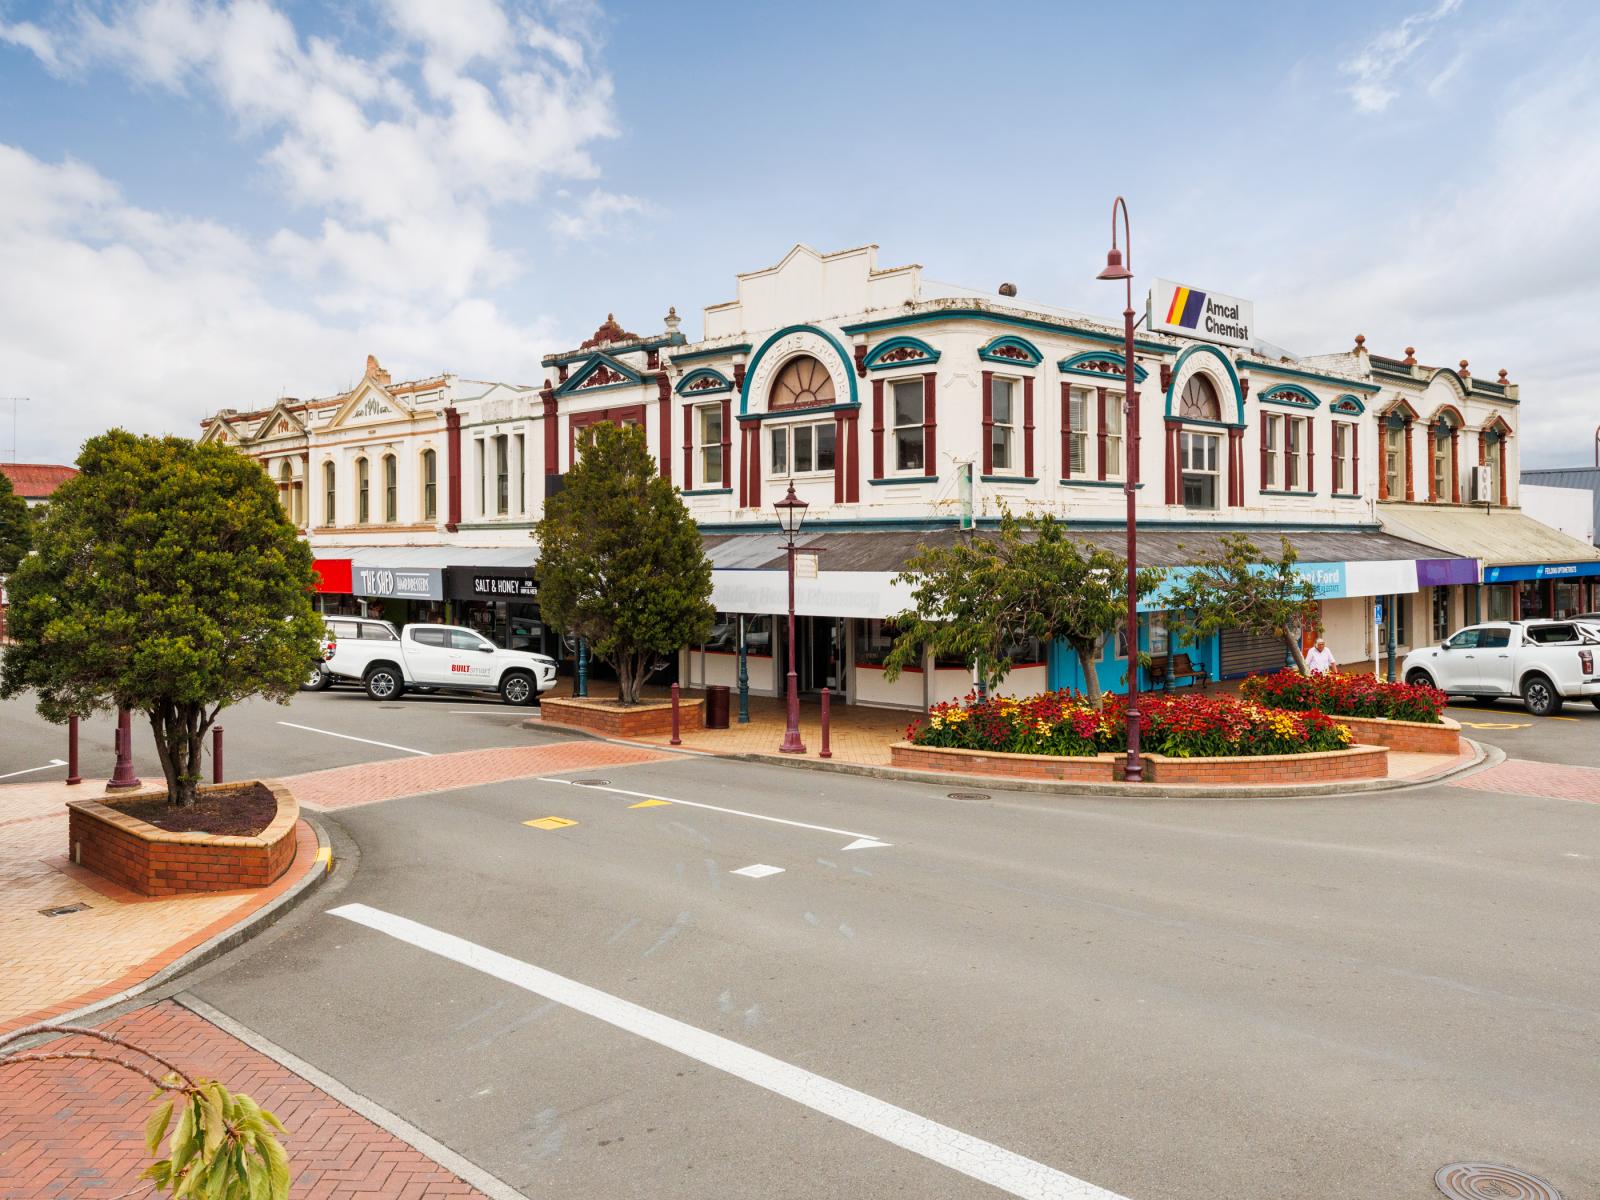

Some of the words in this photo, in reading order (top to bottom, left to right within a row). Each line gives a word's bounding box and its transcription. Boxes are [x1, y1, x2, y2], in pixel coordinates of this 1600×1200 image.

[1206, 298, 1239, 320] Amcal
[1205, 316, 1249, 340] Chemist
[360, 570, 376, 595] THE
[376, 570, 394, 595] SHED
[475, 579, 490, 592] SALT
[491, 580, 497, 593] &
[498, 580, 520, 594] HONEY
[1317, 569, 1340, 585] Ford
[807, 587, 881, 613] Pharmacy
